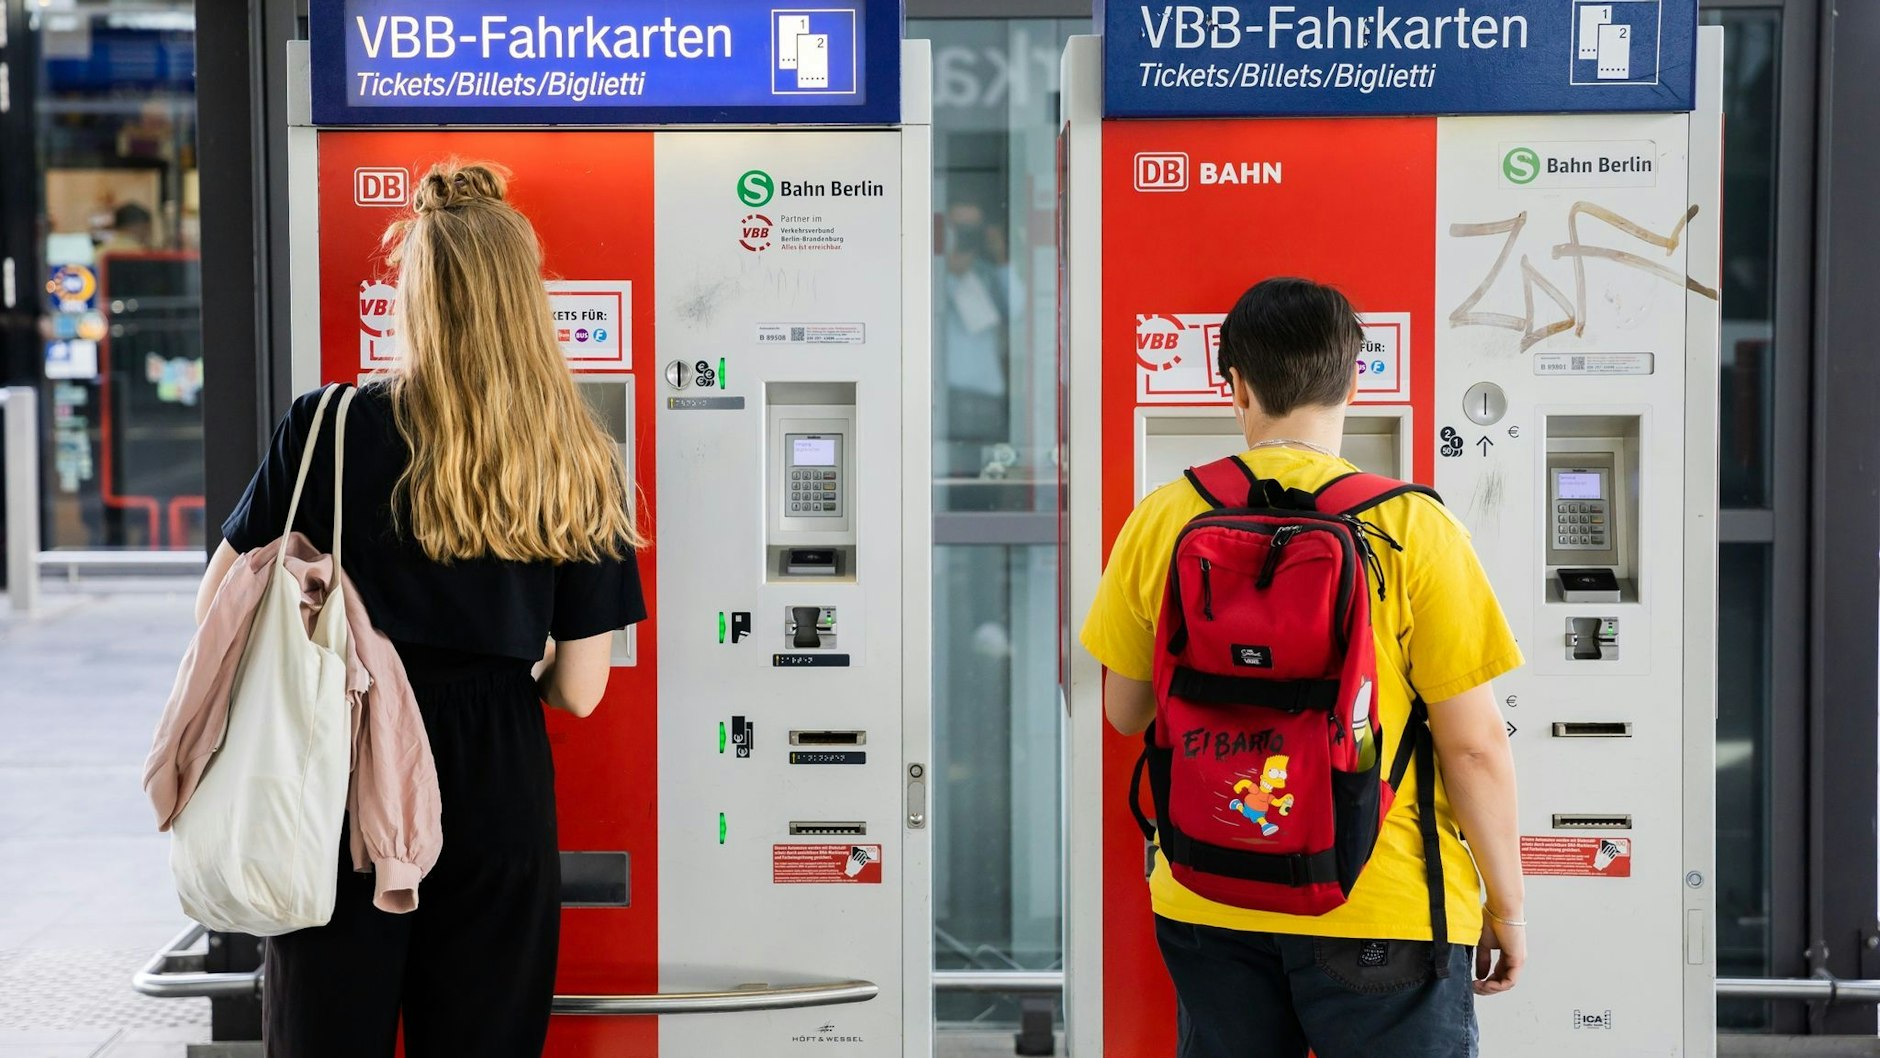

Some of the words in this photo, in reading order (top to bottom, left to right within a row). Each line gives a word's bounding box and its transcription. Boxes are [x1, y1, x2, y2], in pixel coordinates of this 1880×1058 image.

[1602, 9, 1608, 19] 1
[800, 18, 806, 29] 1
[1140, 4, 1528, 49] VBB-Fahrkarten
[356, 15, 732, 58] VBB-Fahrkarten
[1618, 28, 1627, 38] 2
[816, 38, 824, 49] 2
[356, 72, 645, 100] Tickets/Billets/Biglietti
[1138, 62, 1436, 94] Tickets/Billets/Biglietti
[1142, 160, 1180, 184] DB
[1200, 162, 1282, 184] BAHN
[1547, 158, 1592, 173] Bahn
[1598, 156, 1652, 173] Berlin
[363, 175, 401, 199] DB
[780, 180, 824, 196] Bahn
[831, 180, 884, 196] Berlin
[780, 214, 810, 222] Partner
[812, 214, 822, 222] im
[742, 228, 769, 238] VBB
[582, 309, 607, 320] FÜR:
[1136, 333, 1179, 350] VBB
[1444, 429, 1451, 438] 2
[1215, 728, 1284, 761] BARTO
